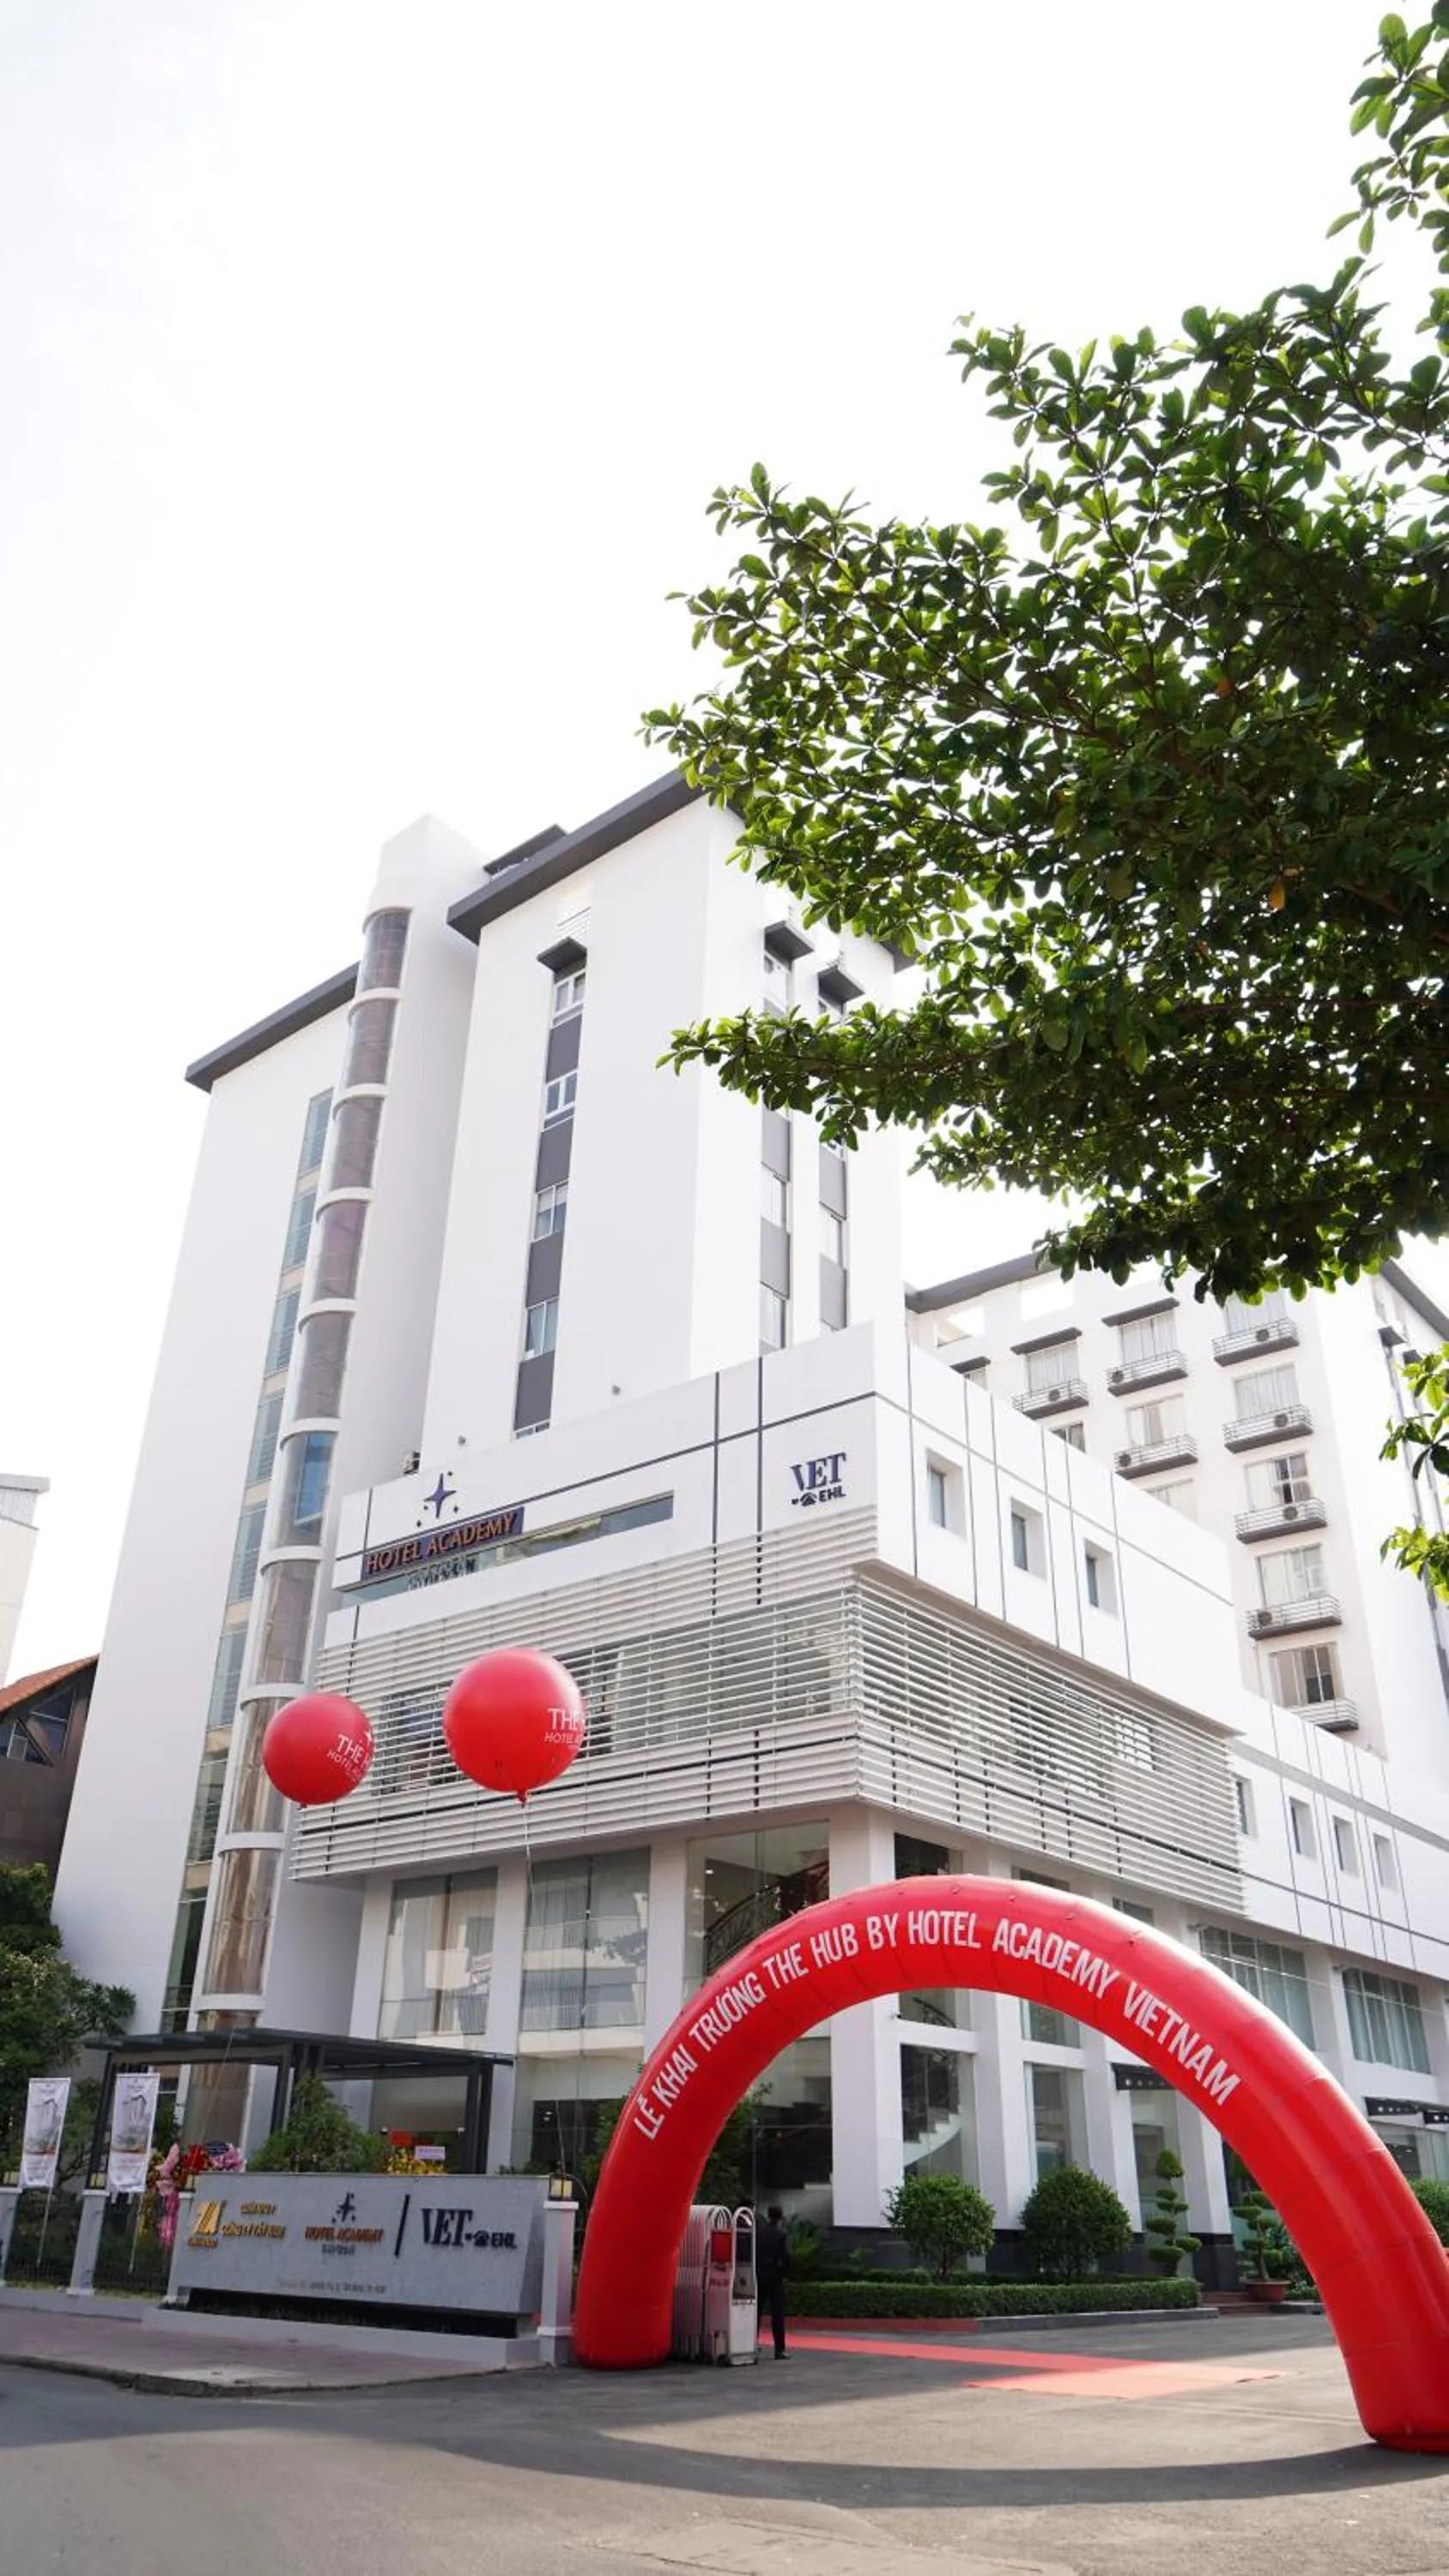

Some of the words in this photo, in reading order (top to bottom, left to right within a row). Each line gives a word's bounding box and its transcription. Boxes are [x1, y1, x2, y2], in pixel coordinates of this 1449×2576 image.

[790, 1452, 846, 1492] VET
[818, 1485, 847, 1503] EHL
[366, 1541, 422, 1574] HOTEL
[425, 1511, 517, 1557] ACADEMY
[546, 1708, 579, 1731] THE
[337, 1734, 364, 1764] THE
[652, 2043, 699, 2109] KHAI
[762, 1942, 809, 1990] THE
[809, 1922, 859, 1969] HUB
[865, 1912, 900, 1950] BY
[907, 1910, 981, 1949] HOTEL
[992, 1917, 1121, 2000] ACADEMY
[1123, 1979, 1241, 2106] VIETNAM
[421, 2208, 474, 2247] VET
